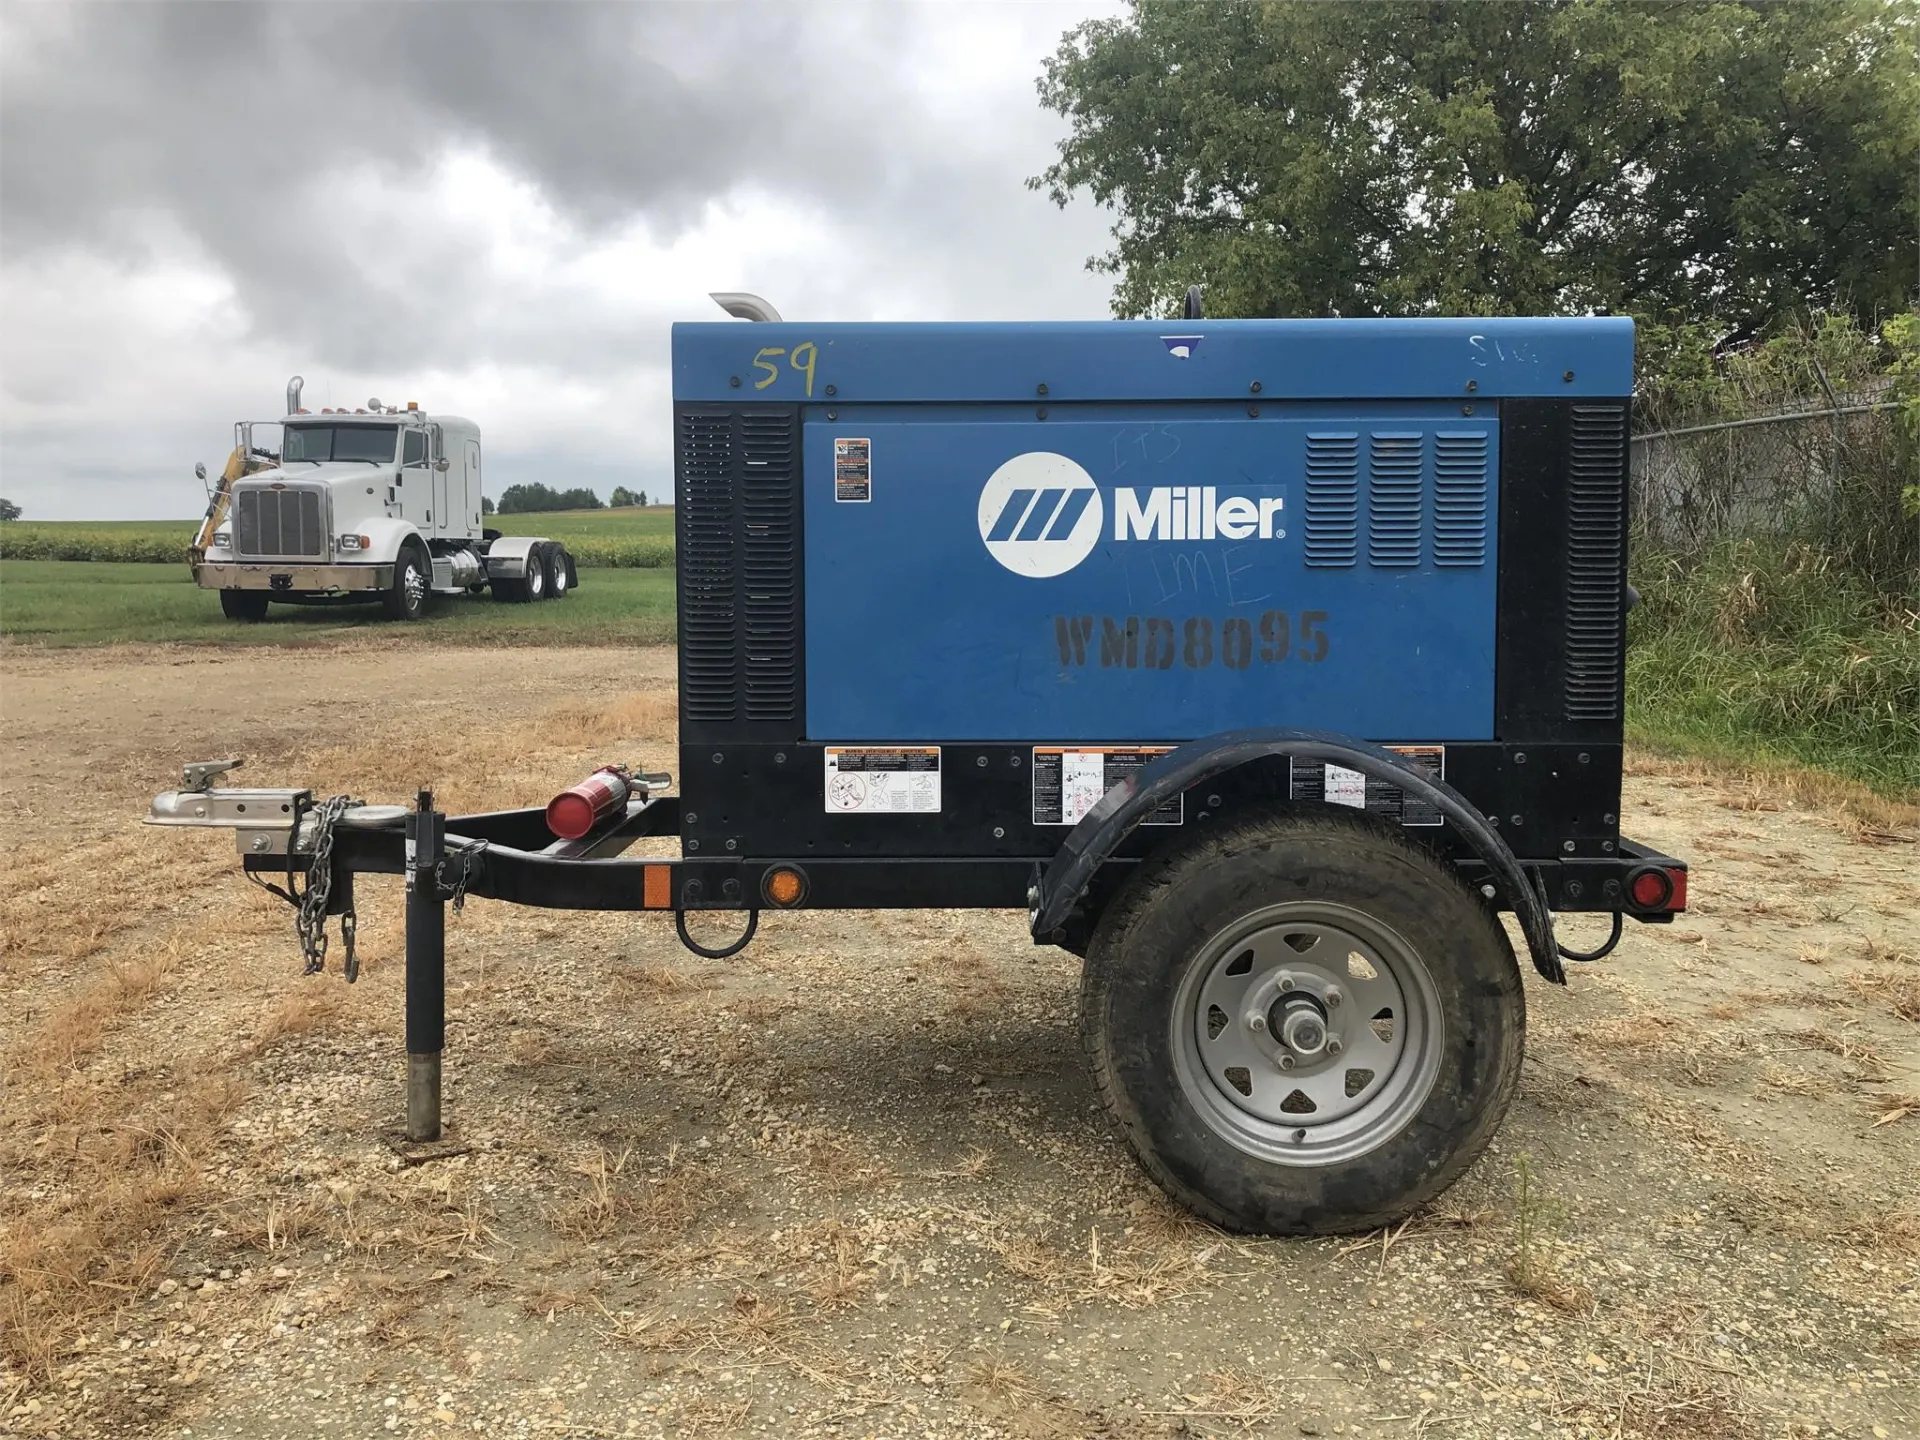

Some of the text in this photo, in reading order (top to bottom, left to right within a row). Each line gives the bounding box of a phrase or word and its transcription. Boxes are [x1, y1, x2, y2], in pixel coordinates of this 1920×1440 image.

[752, 341, 818, 398] 59
[1114, 486, 1284, 541] Miller
[1054, 609, 1330, 670] WMD8095
